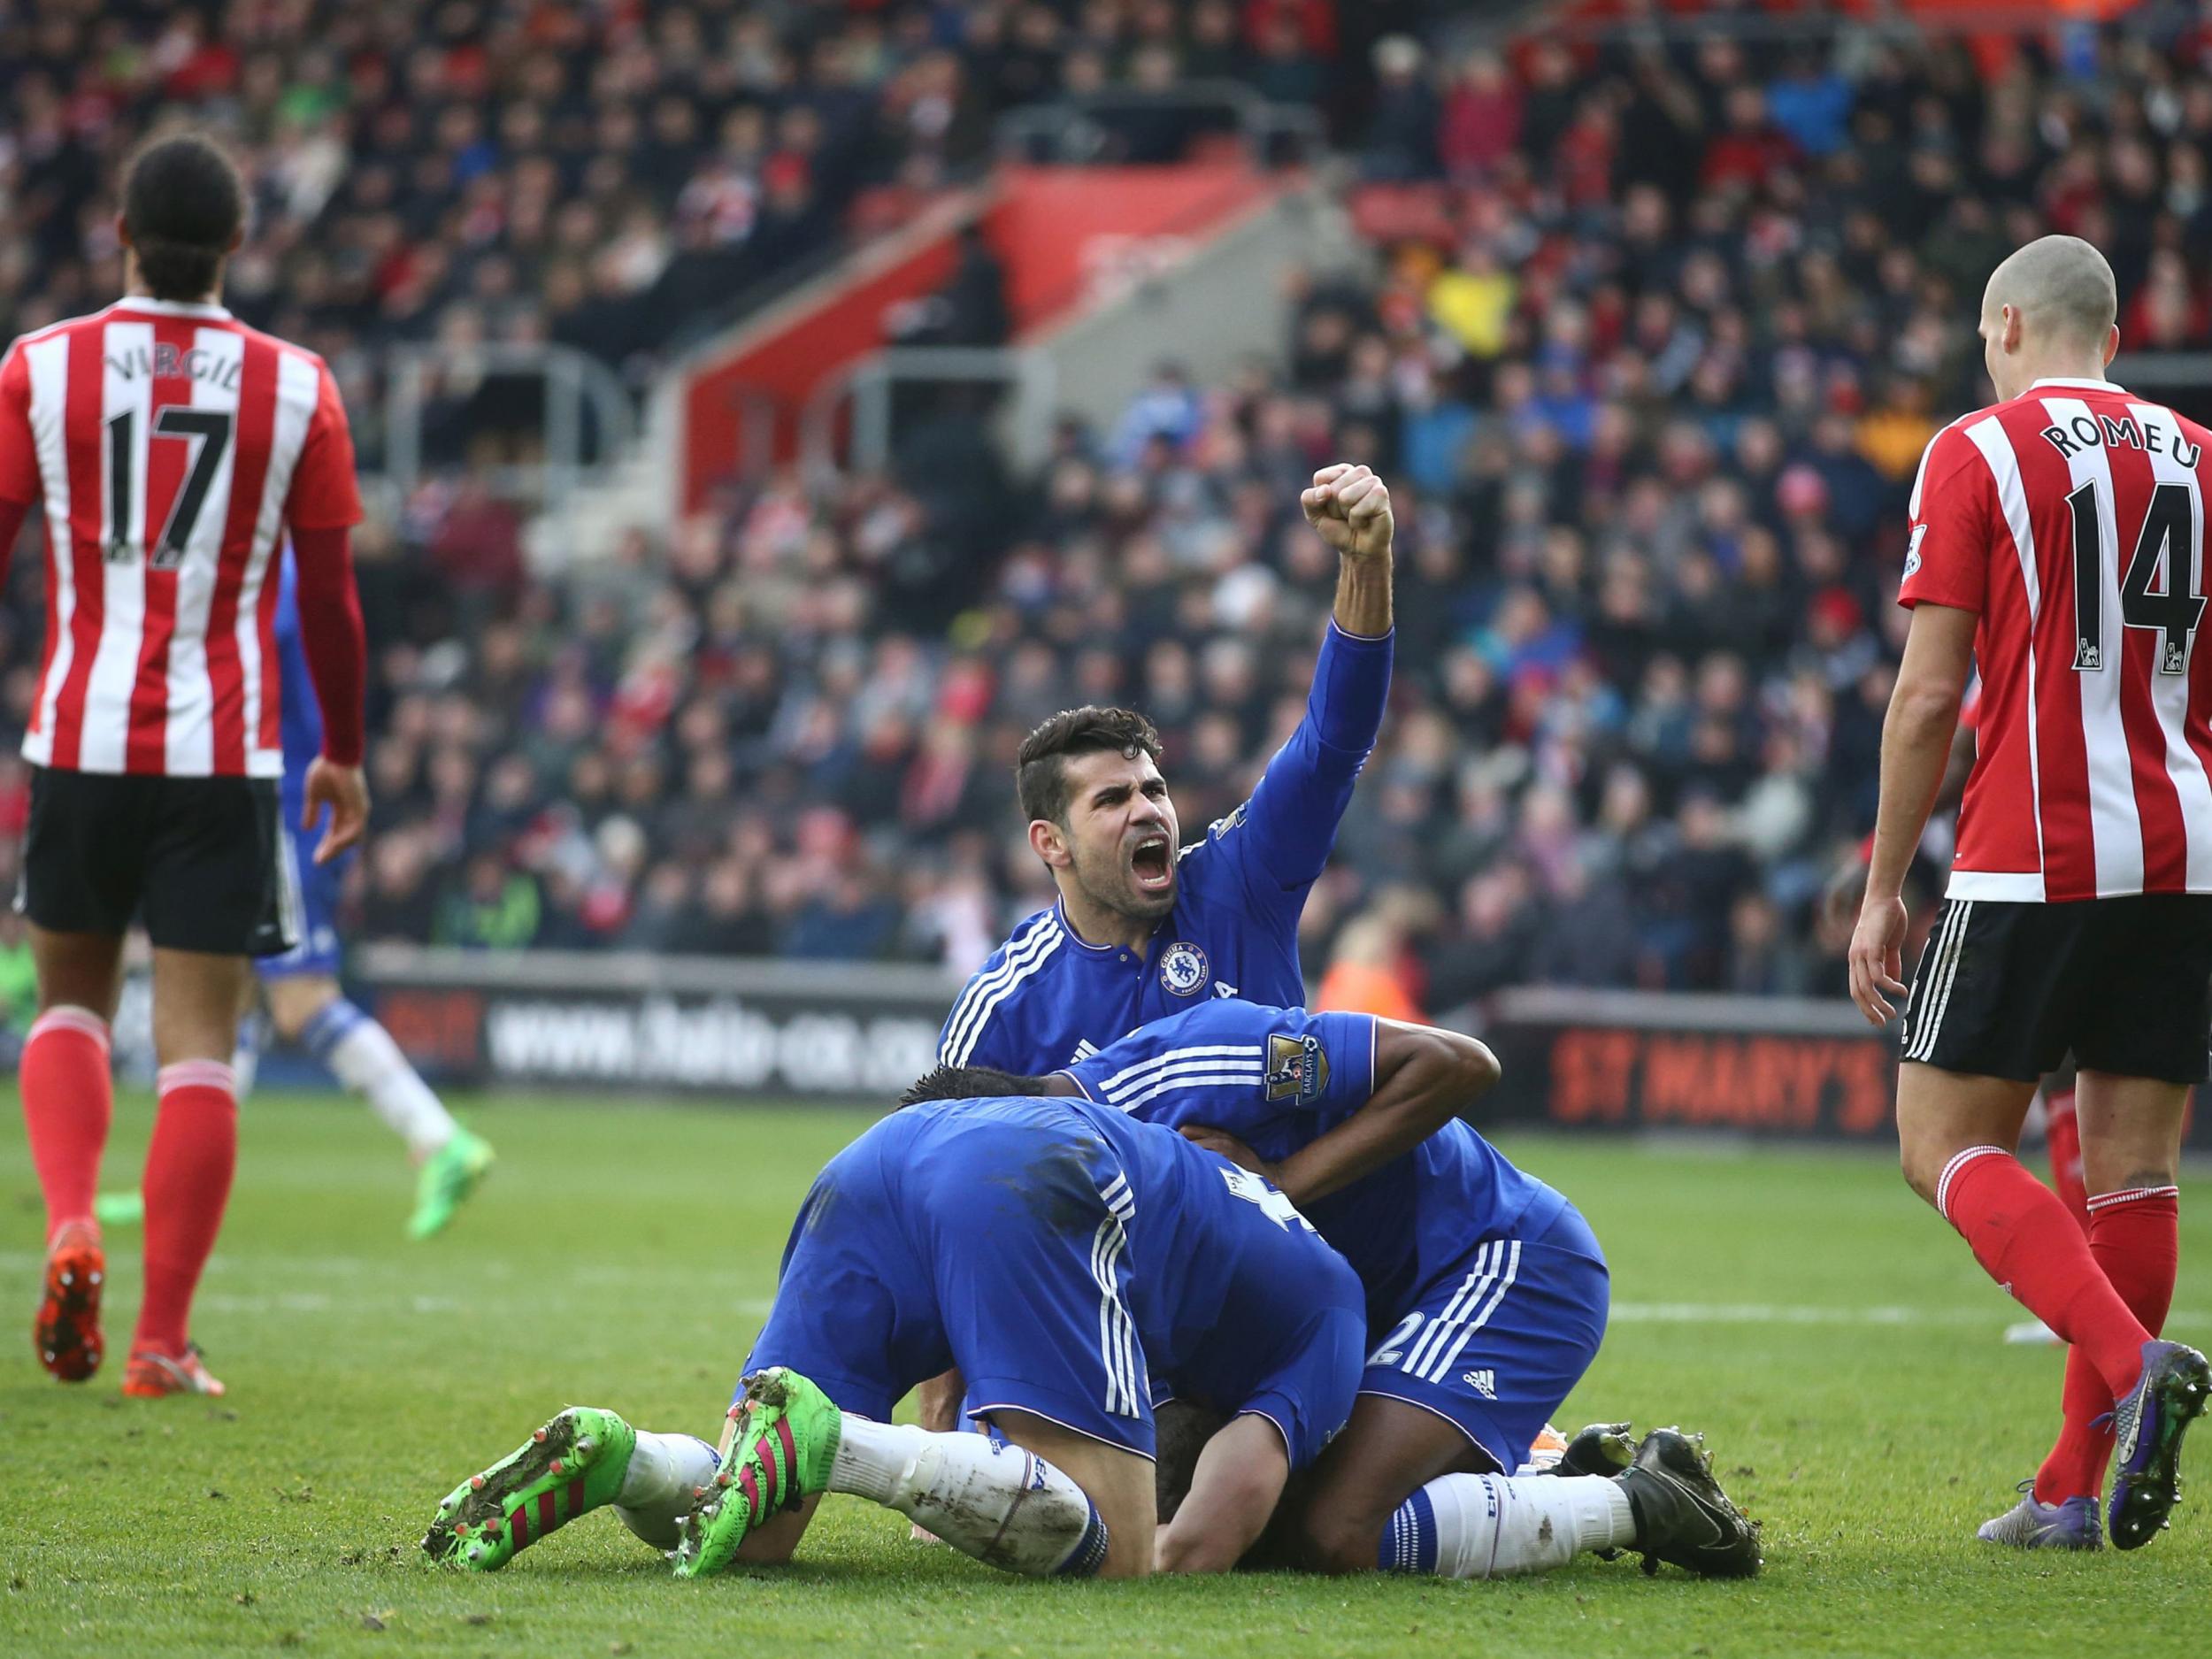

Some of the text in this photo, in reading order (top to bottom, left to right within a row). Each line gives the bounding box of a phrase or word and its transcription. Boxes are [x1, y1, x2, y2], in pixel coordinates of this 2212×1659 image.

[105, 342, 244, 392] VIRGIL
[2042, 415, 2200, 470] ROMEU
[104, 404, 236, 570] 17
[2064, 478, 2208, 674] 14
[1161, 944, 1184, 969] CHELSEA
[1365, 1310, 1425, 1366] 2
